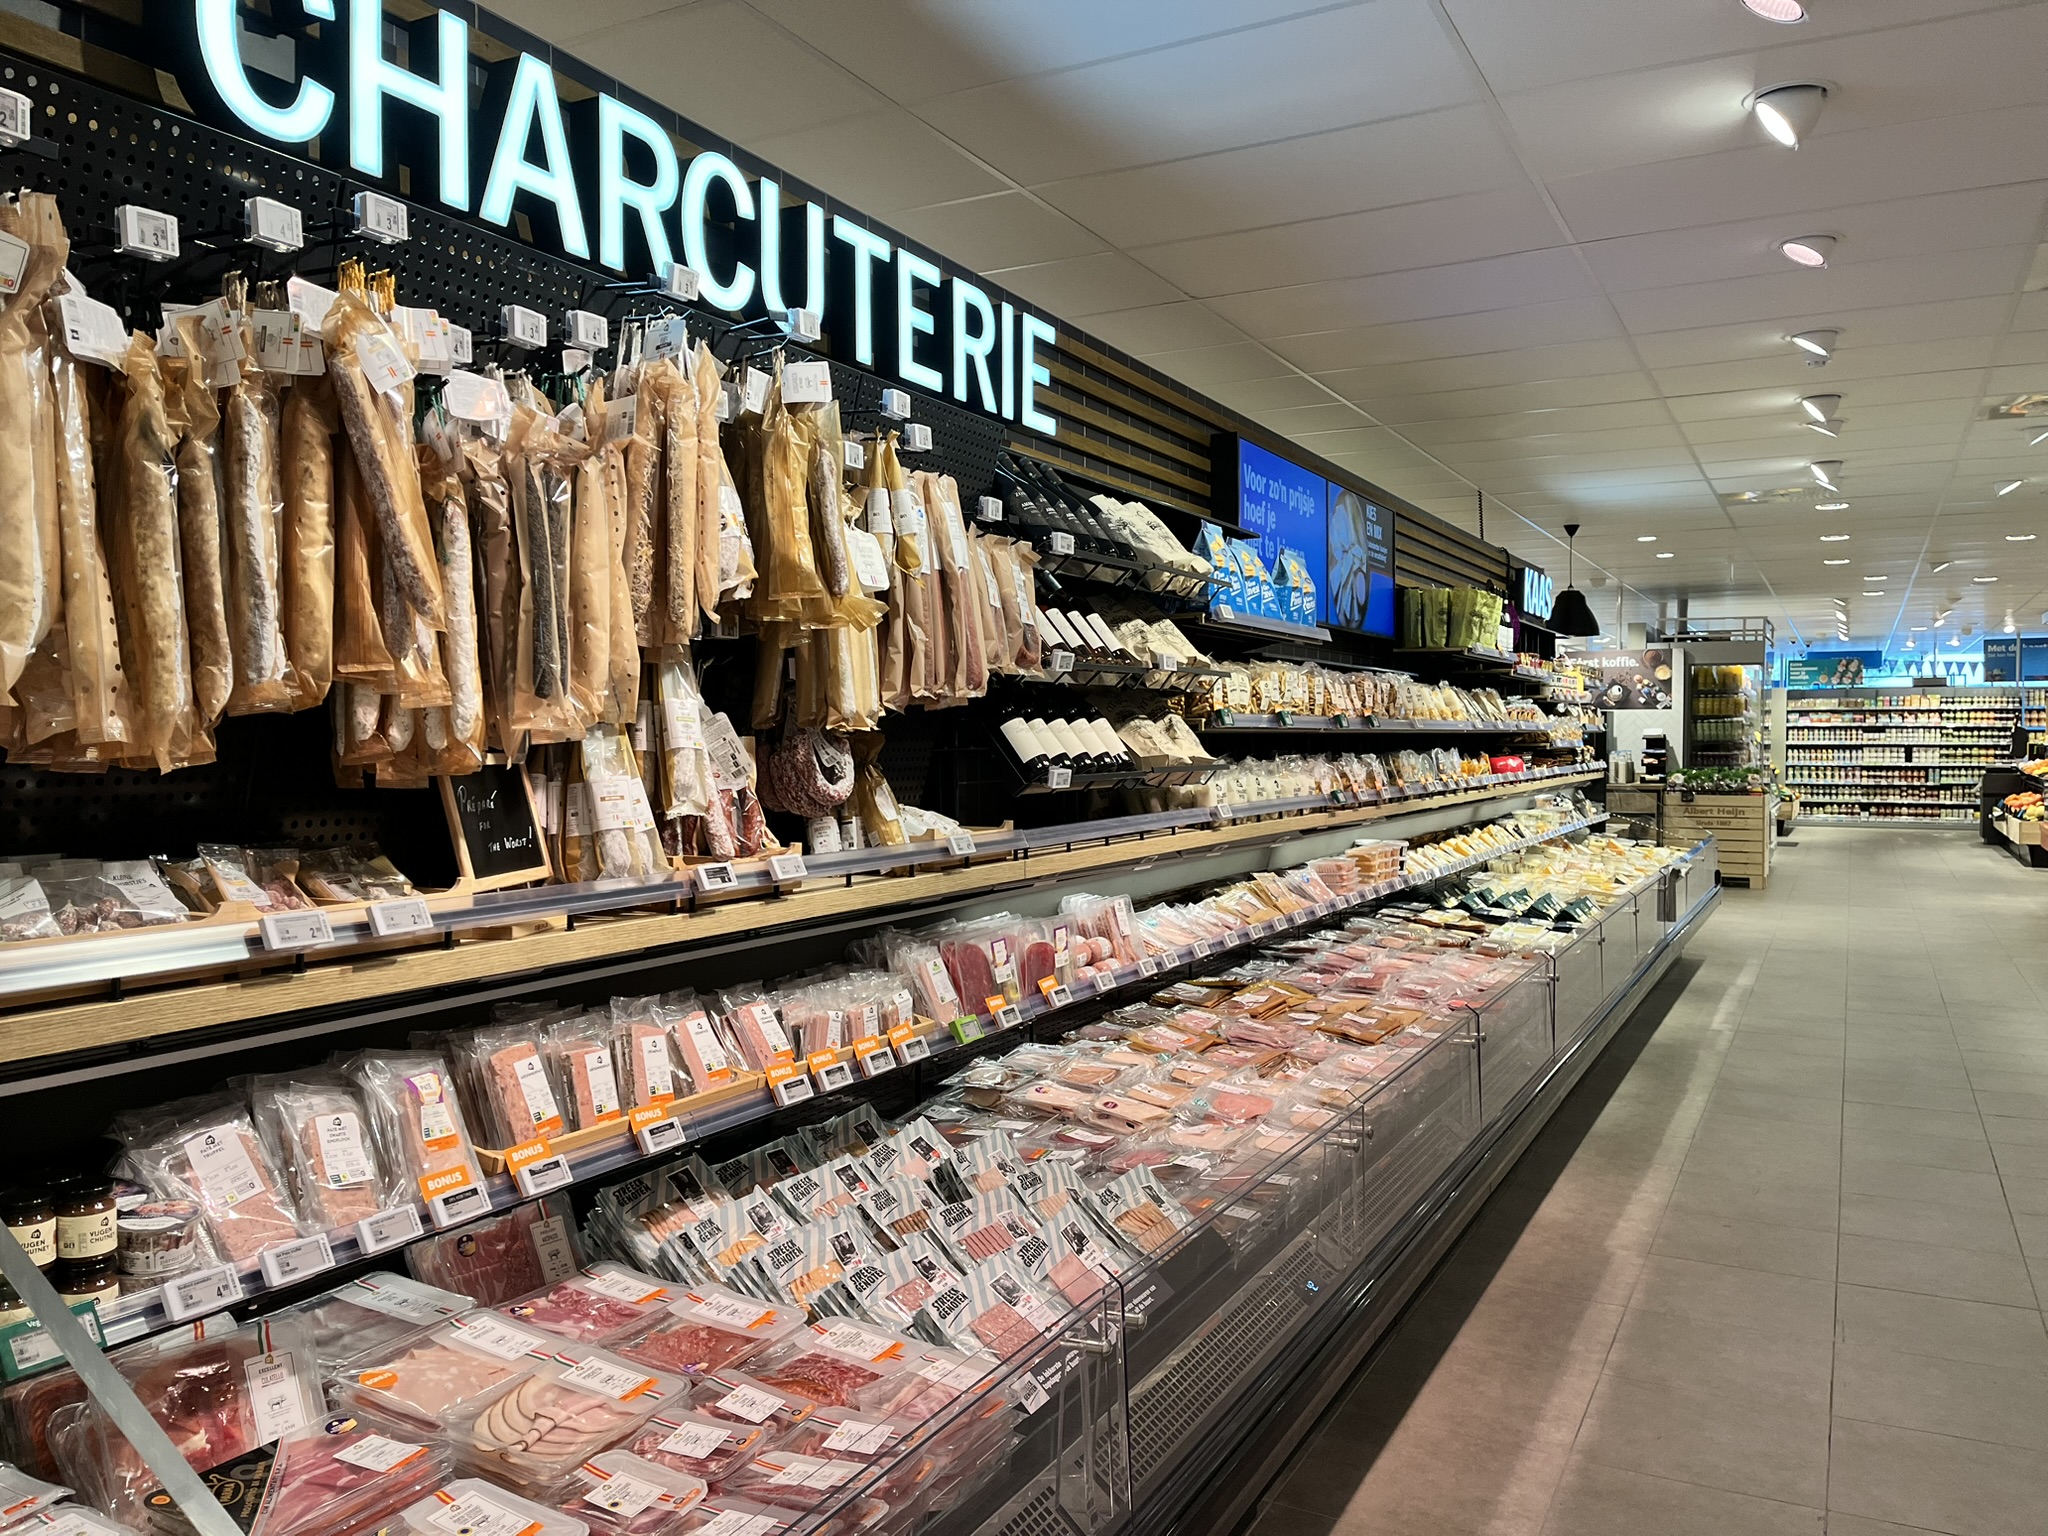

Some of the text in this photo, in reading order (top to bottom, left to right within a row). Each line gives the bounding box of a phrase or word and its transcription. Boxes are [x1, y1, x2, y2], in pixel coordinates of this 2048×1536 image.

[194, 0, 1057, 437] CHARCUTERIE
[1243, 462, 1315, 518] Voor zo'n prijsje
[1243, 493, 1277, 533] hoef je
[1265, 535, 1275, 560] te
[1523, 566, 1553, 621] KAAS
[1987, 644, 2006, 653] Met
[1602, 656, 1640, 668] koffie.
[1683, 807, 1746, 818] Albert Heijn
[892, 1026, 909, 1039] BONUS
[857, 1039, 876, 1052] BONUS
[811, 1052, 833, 1065] BONUS
[770, 1065, 793, 1079] BONUS
[634, 1108, 663, 1122] BONUS
[511, 1143, 544, 1163] BONUS
[870, 1144, 891, 1162] STREECK
[875, 1148, 898, 1168] GENOTEN
[715, 1158, 742, 1178] STREECK
[719, 1163, 750, 1185] GENOTEN
[427, 1171, 463, 1191] BONUS
[612, 1177, 645, 1201] STREECK
[787, 1175, 814, 1195] STREECK
[617, 1183, 652, 1207] GENOTEN
[792, 1181, 821, 1202] GENOTEN
[939, 1202, 967, 1221] STREECK
[944, 1207, 973, 1227] GENOTEN
[89, 1227, 113, 1237] VIJGEN
[89, 1232, 115, 1244] CHUTNEY
[24, 1245, 50, 1255] HUTNEY
[767, 1238, 798, 1261] STREECK
[1016, 1235, 1042, 1260] STREECK
[1023, 1240, 1049, 1268] GENOTEN
[771, 1246, 804, 1270] GENOTEN
[849, 1265, 876, 1285] STREEC
[932, 1287, 960, 1312] STREECK
[938, 1292, 969, 1320] GENOTEN
[258, 1362, 283, 1374] EXCELLENT
[261, 1371, 284, 1384] CULATELLO
[365, 1371, 393, 1387] BONUS
